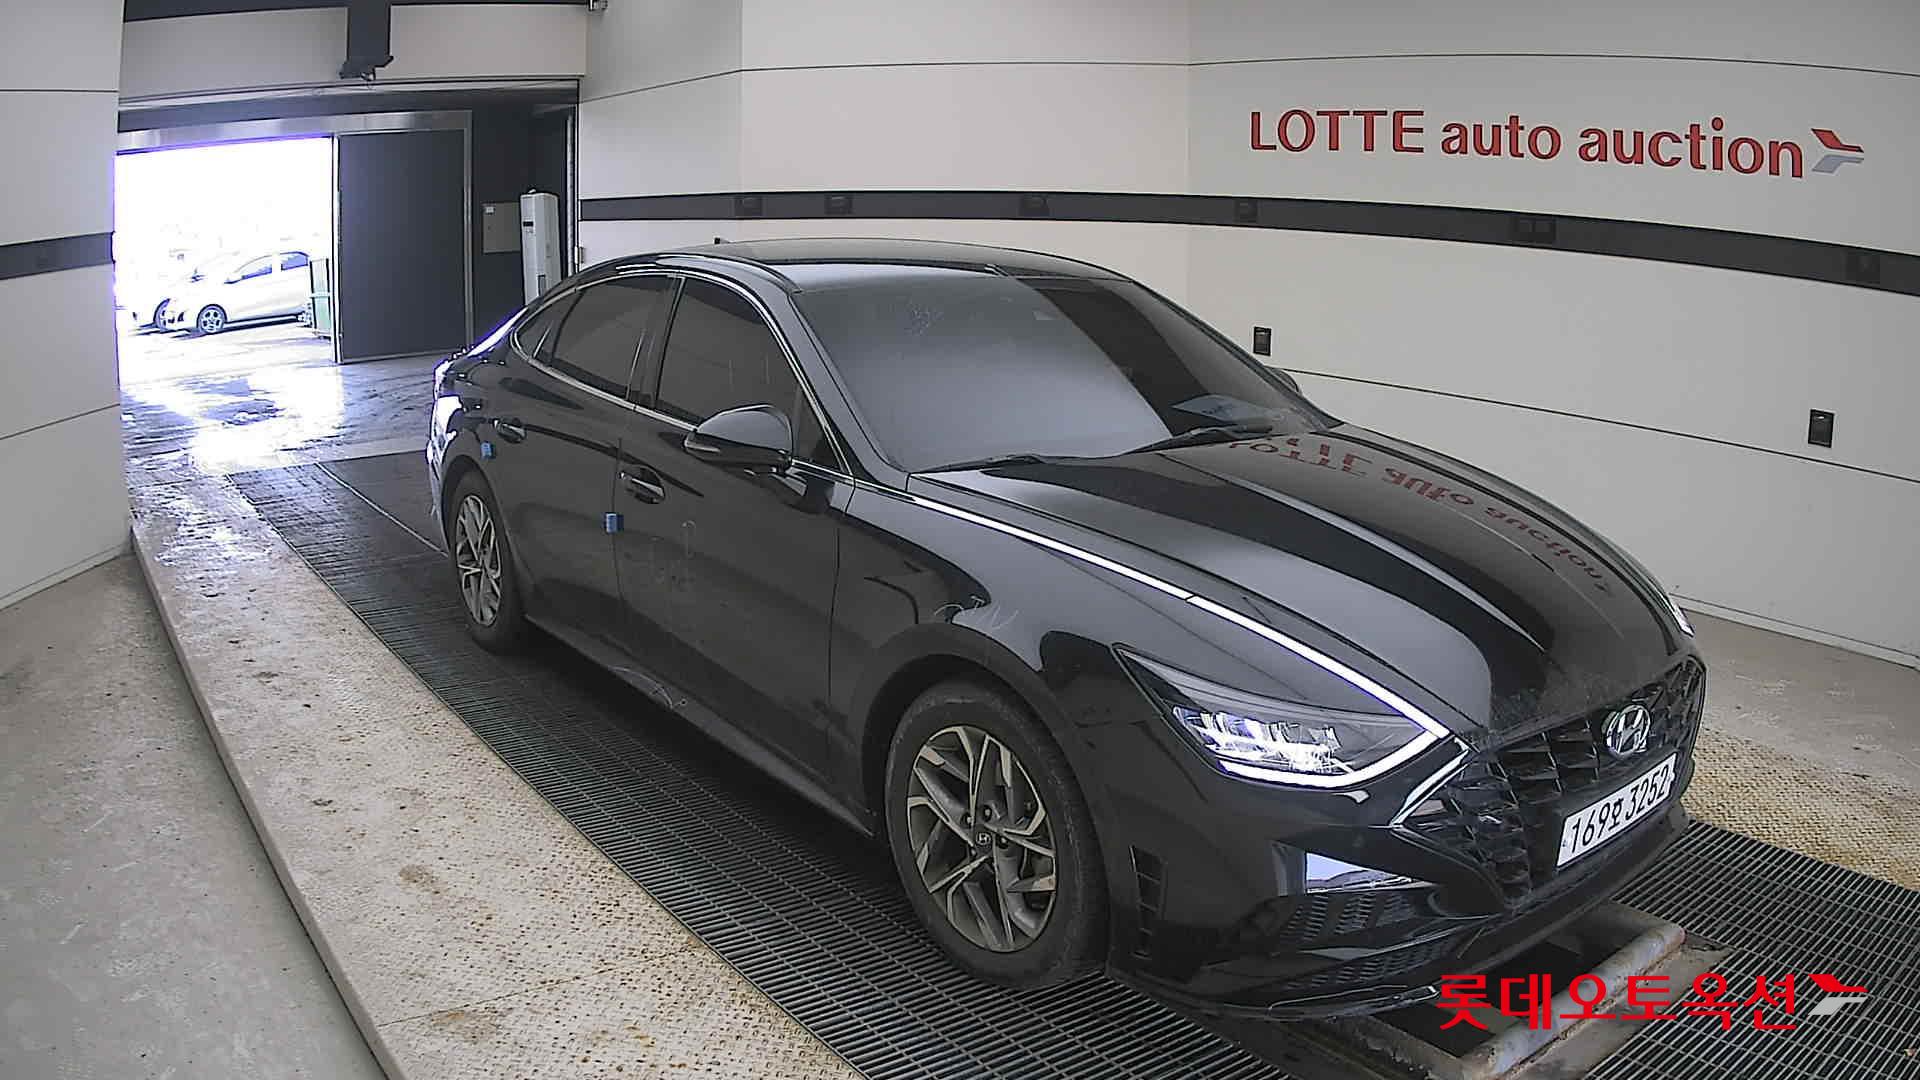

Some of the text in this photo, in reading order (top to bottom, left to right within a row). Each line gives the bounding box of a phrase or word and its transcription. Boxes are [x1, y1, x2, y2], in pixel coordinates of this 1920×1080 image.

[1250, 109, 1802, 178] LOTTE auto auction
[1571, 764, 1669, 853] 169호 3252
